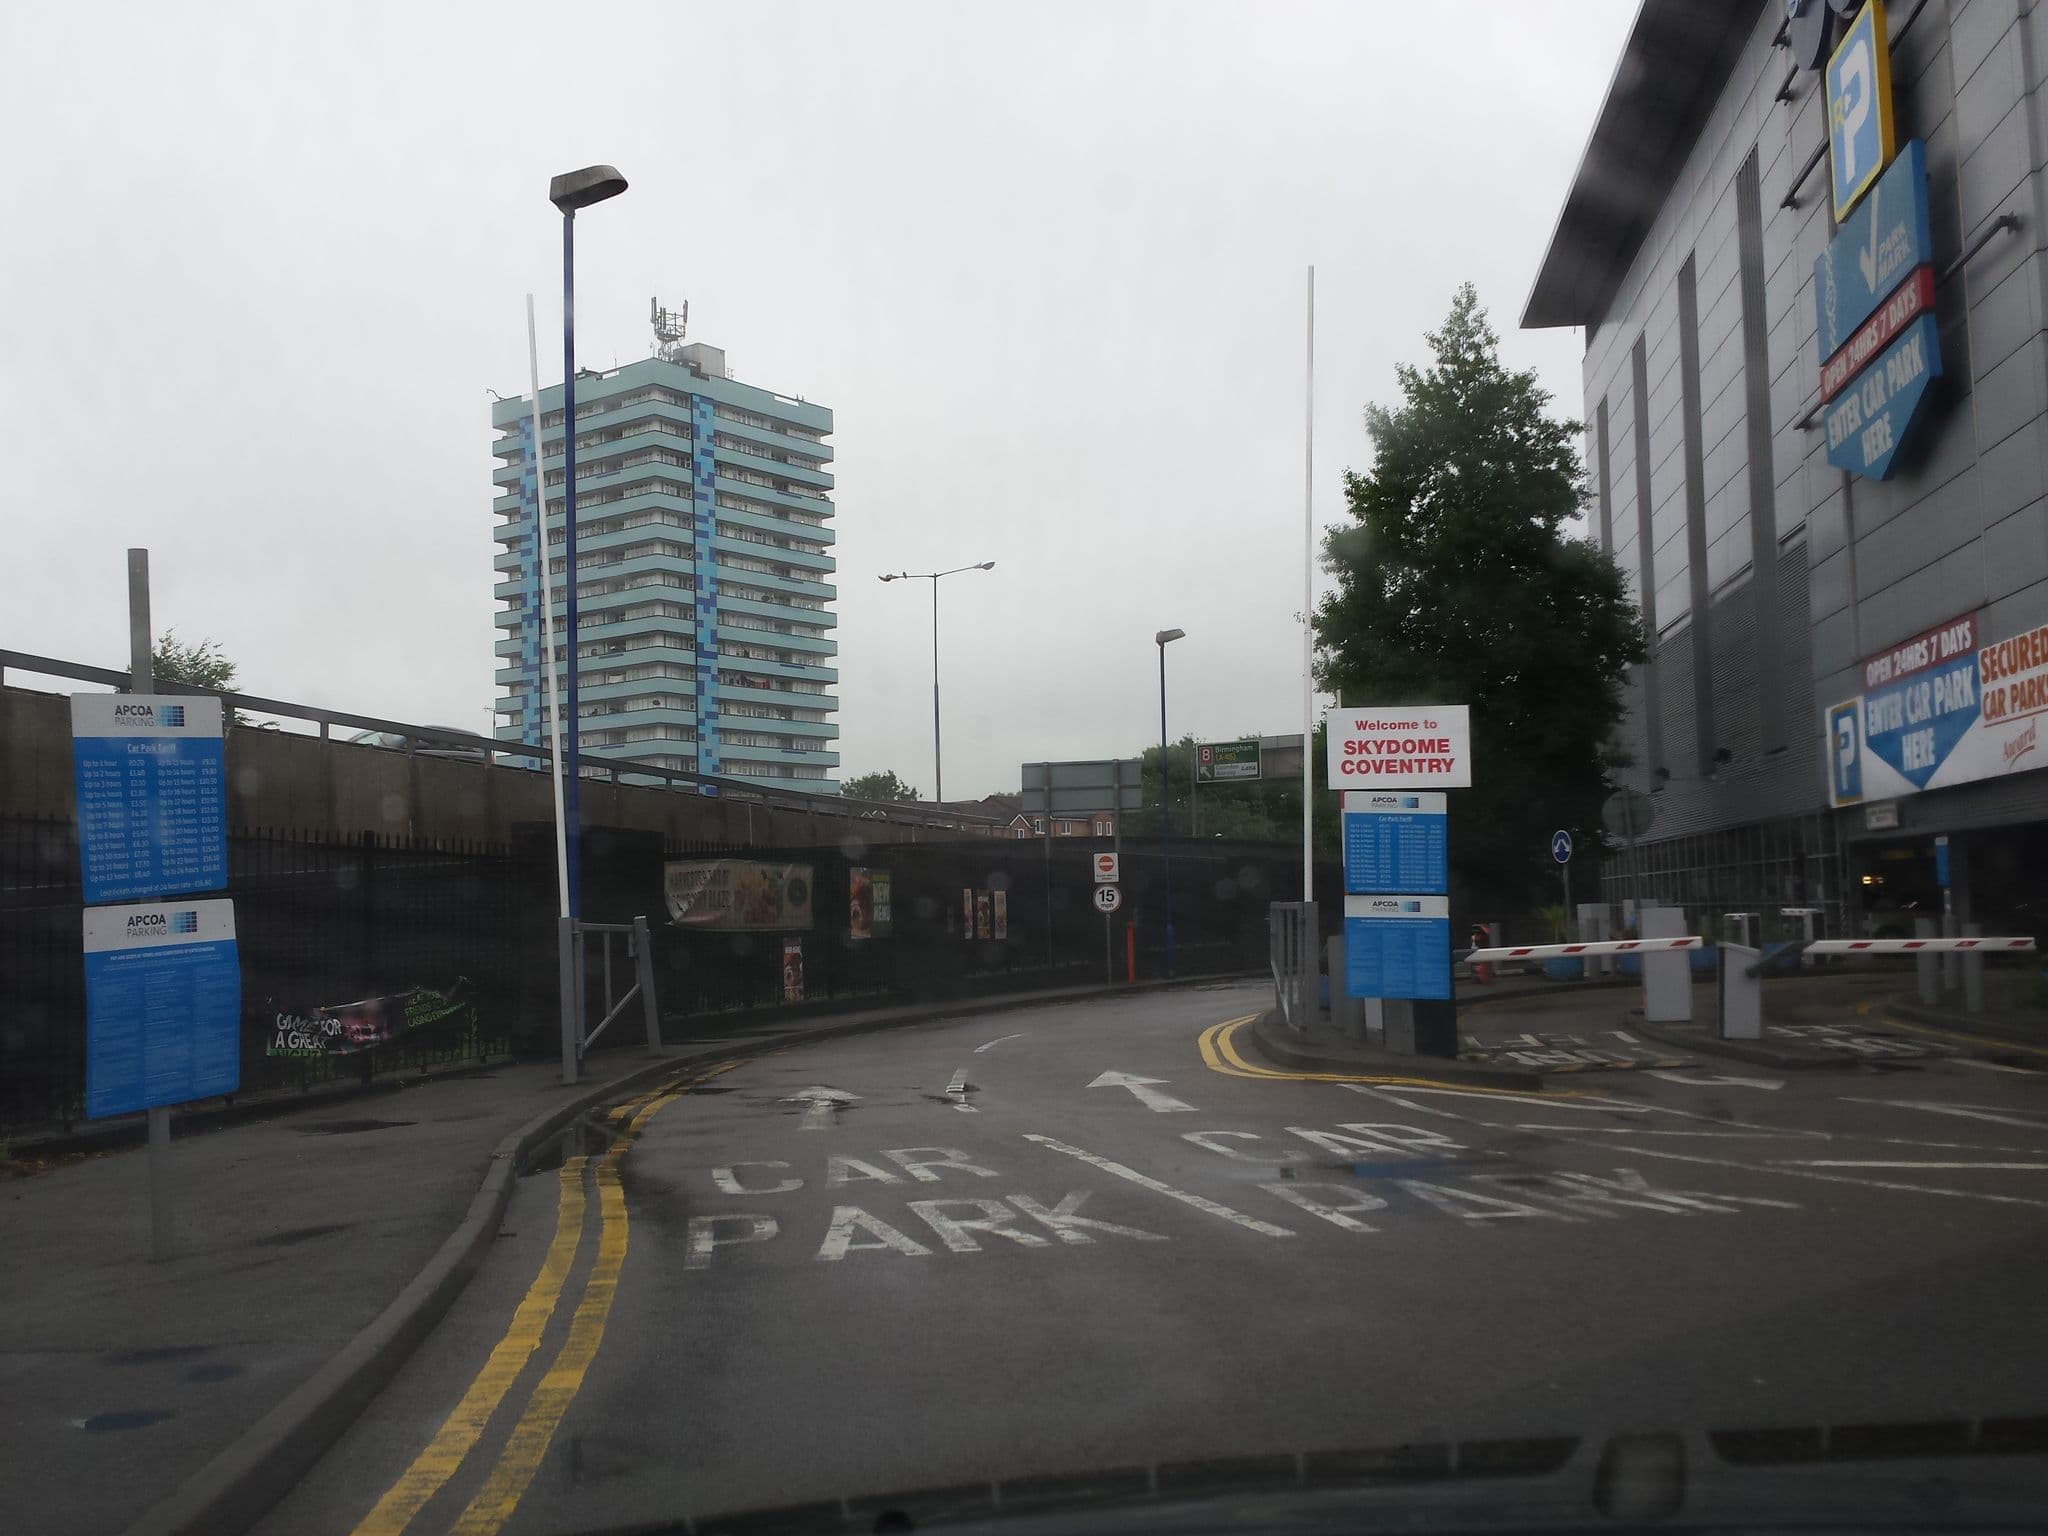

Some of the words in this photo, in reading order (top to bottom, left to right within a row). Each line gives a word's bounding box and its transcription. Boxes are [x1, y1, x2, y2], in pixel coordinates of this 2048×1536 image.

[1840, 39, 1870, 184] P
[1824, 353, 1846, 393] OPEN
[1848, 320, 1879, 366] 24HRS
[1880, 311, 1886, 338] 7
[1889, 282, 1916, 328] DAYS
[1828, 392, 1862, 451] ENTER
[1862, 369, 1887, 418] CAR
[1886, 334, 1924, 398] PARK
[1862, 411, 1893, 467] HERE
[1867, 656, 1891, 687] OPEN
[1894, 639, 1928, 677] 24HRS
[1931, 634, 1938, 662] 7
[1941, 621, 1971, 657] DAYS
[1980, 627, 2048, 685] SECURED
[115, 705, 153, 716] APCOA
[1867, 691, 1904, 736] ENTER
[1905, 681, 1931, 724] CAR
[1934, 665, 1974, 716] PARK
[1983, 688, 2006, 721] CAR
[114, 717, 155, 727] PARKING
[1355, 720, 1419, 731] Welcome
[1423, 719, 1438, 729] to
[128, 744, 139, 753] Car
[141, 744, 156, 753] Park
[1202, 749, 1210, 761] 8
[1215, 744, 1254, 753] Birmingham
[1343, 739, 1450, 755] SKYDOME
[1838, 715, 1855, 792] P
[1902, 727, 1936, 771] HERE
[1341, 758, 1456, 775] COVENTRY
[873, 882, 889, 904] NEW
[1098, 889, 1114, 902] 15
[127, 914, 166, 927] APCOA
[127, 926, 167, 937] PARKING
[275, 1031, 285, 1048] A
[712, 1147, 1000, 1195] CAR
[684, 1193, 1170, 1270] PARK
